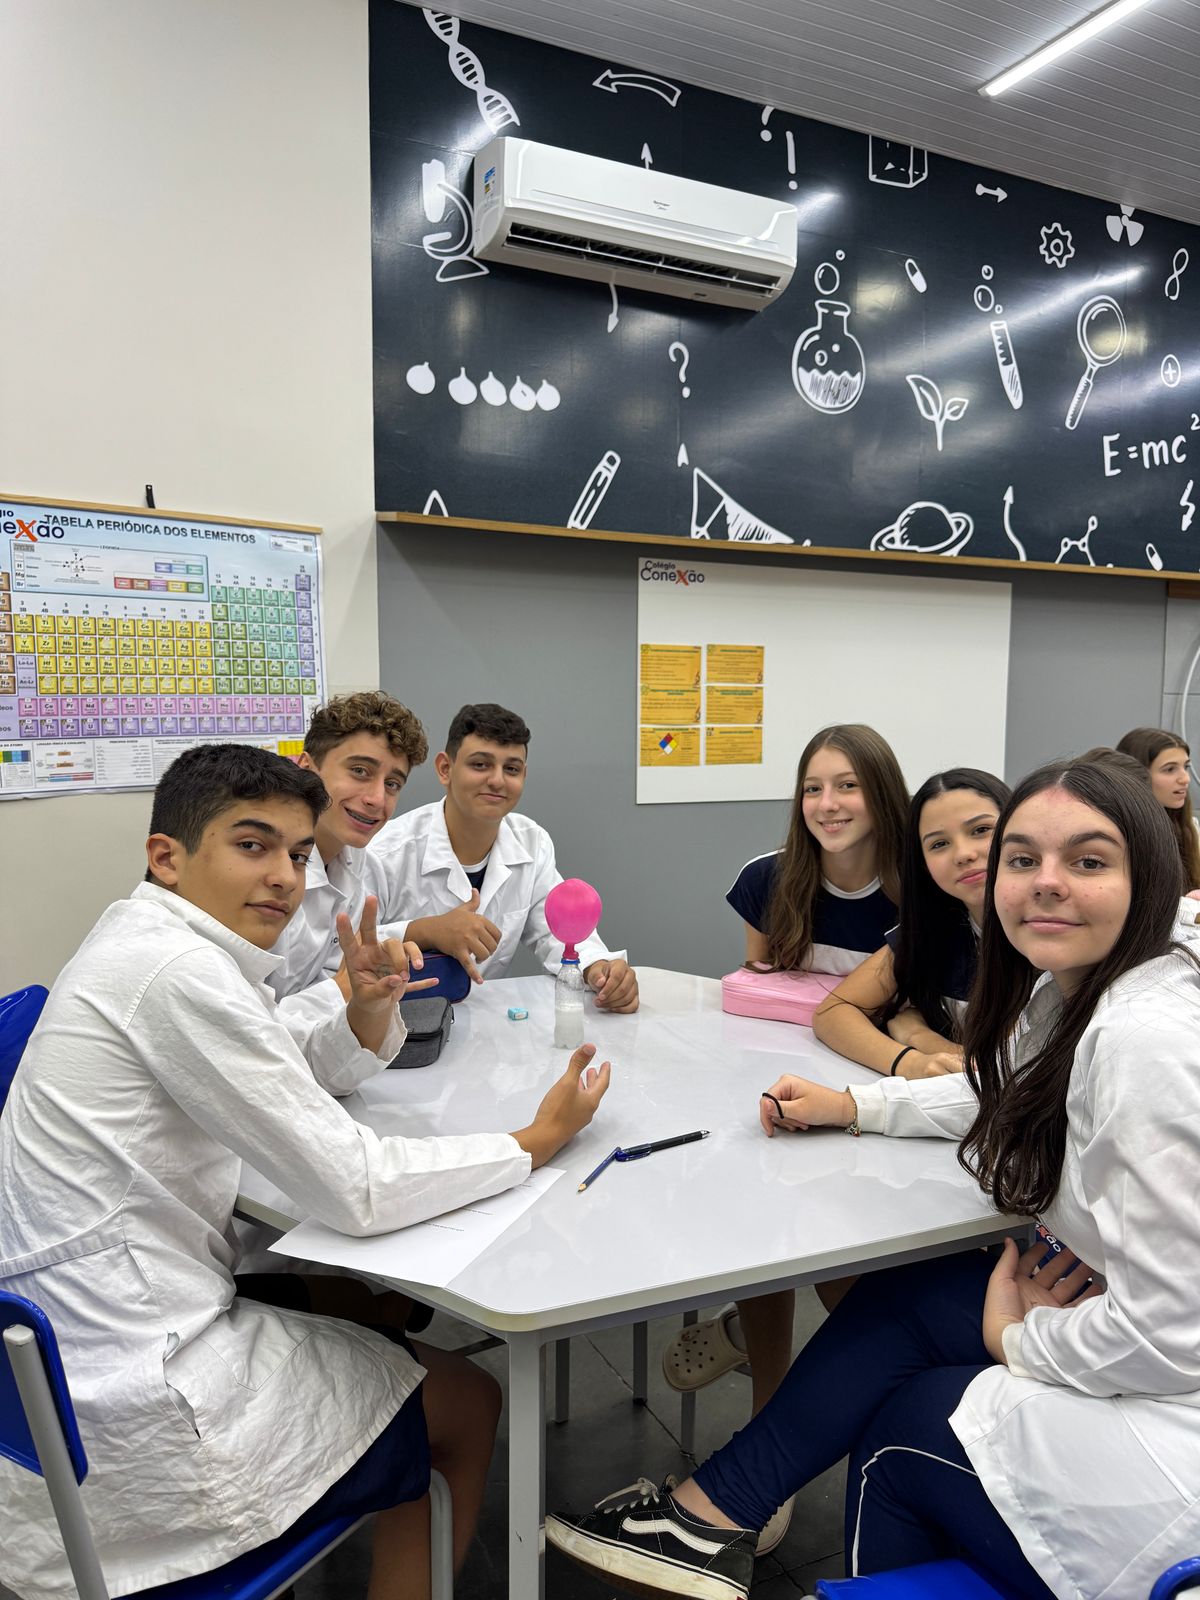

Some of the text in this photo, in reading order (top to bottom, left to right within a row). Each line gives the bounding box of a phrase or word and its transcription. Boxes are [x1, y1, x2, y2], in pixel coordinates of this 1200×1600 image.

[44, 514, 94, 529] TABELA
[97, 518, 161, 535] PERIÓDICA
[164, 527, 188, 538] DOS
[191, 529, 256, 544] ELEMENTOS
[645, 560, 676, 570] Colégio
